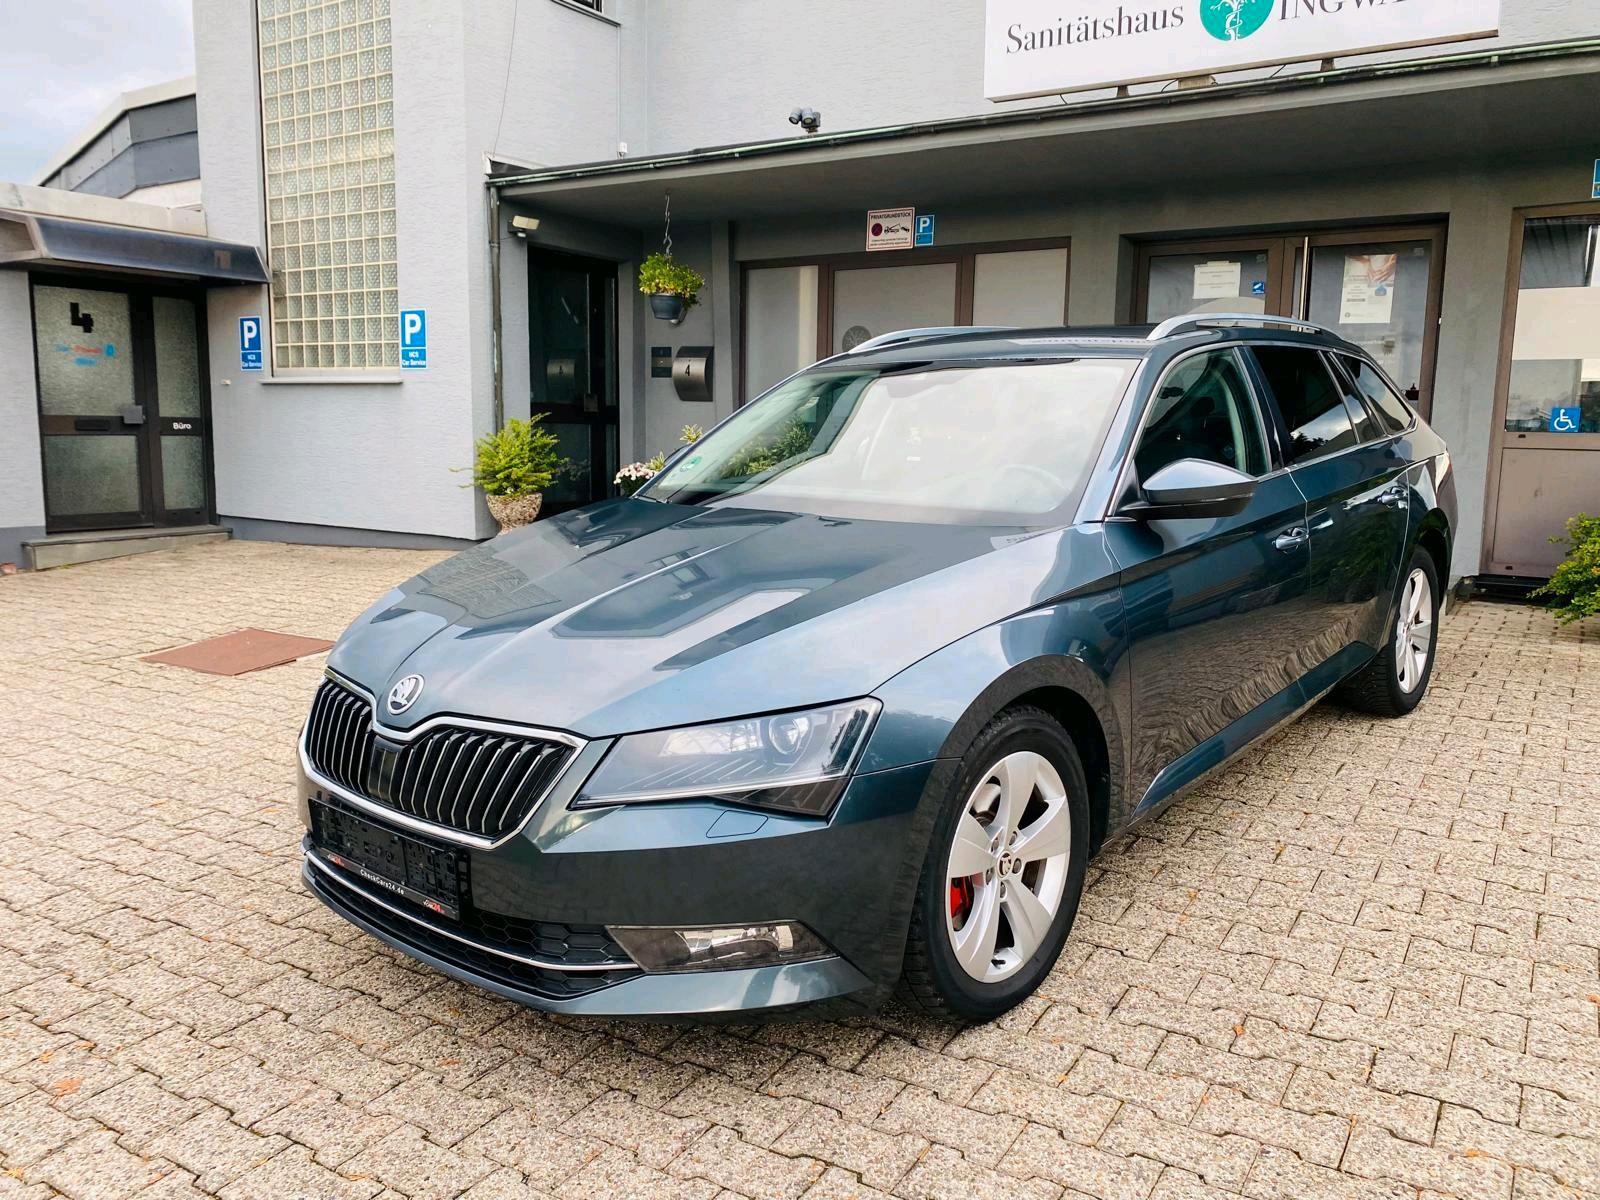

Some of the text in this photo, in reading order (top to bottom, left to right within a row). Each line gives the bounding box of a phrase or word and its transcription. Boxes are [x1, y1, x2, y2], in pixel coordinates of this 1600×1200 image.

[1006, 5, 1184, 54] Sanitätshaus
[920, 218, 930, 232] P
[70, 302, 93, 333] 4
[405, 314, 421, 344] P
[244, 320, 257, 348] P
[685, 364, 690, 376] 4
[173, 421, 192, 430] Büro
